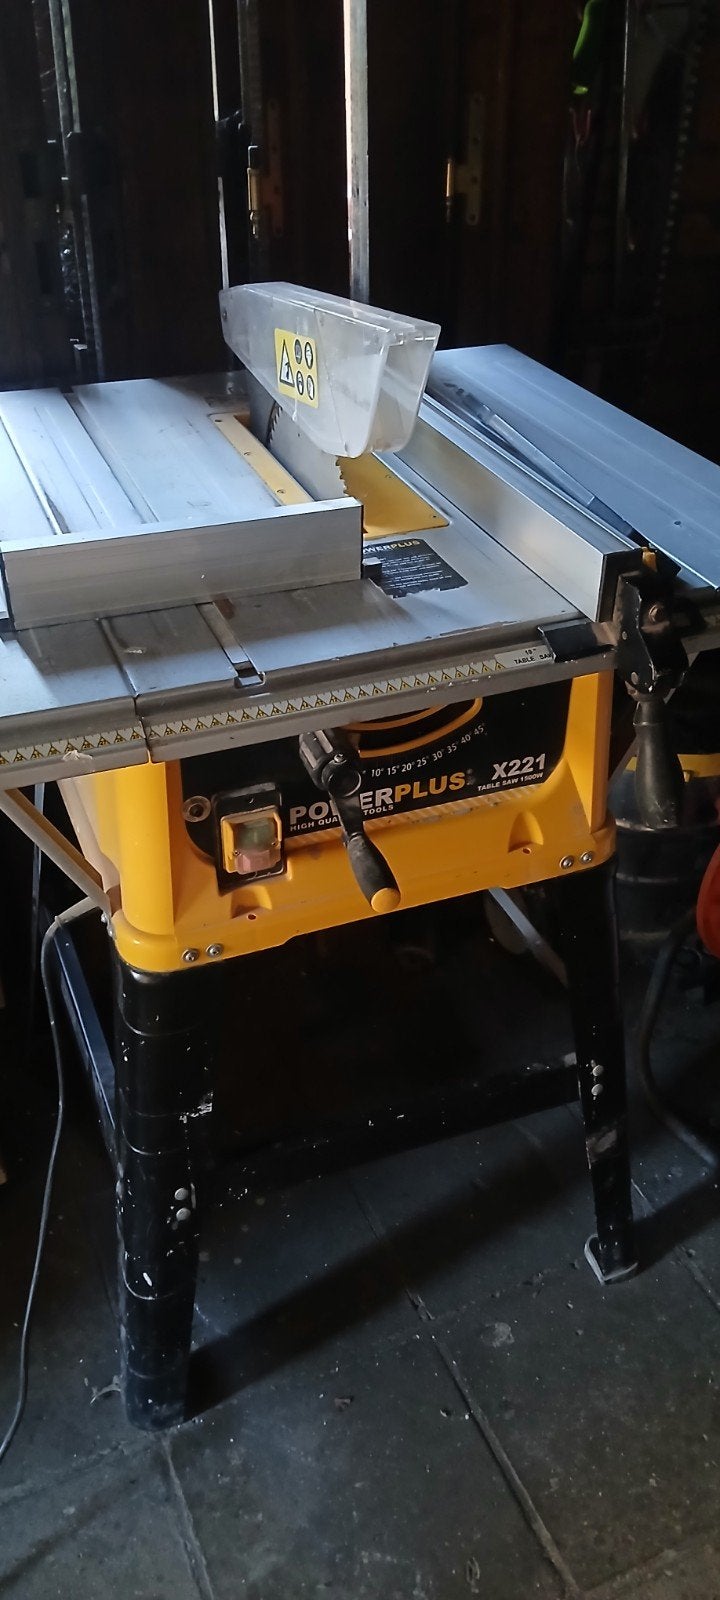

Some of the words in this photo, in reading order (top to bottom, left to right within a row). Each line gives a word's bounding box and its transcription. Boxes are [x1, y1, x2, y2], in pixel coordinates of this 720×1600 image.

[363, 540, 420, 554] WERPLUS
[513, 656, 536, 664] TABLE
[491, 753, 546, 780] X221
[477, 781, 501, 792] TABLE
[502, 777, 519, 786] SAW
[290, 820, 315, 832] HIGH
[363, 804, 394, 816] TOOLS
